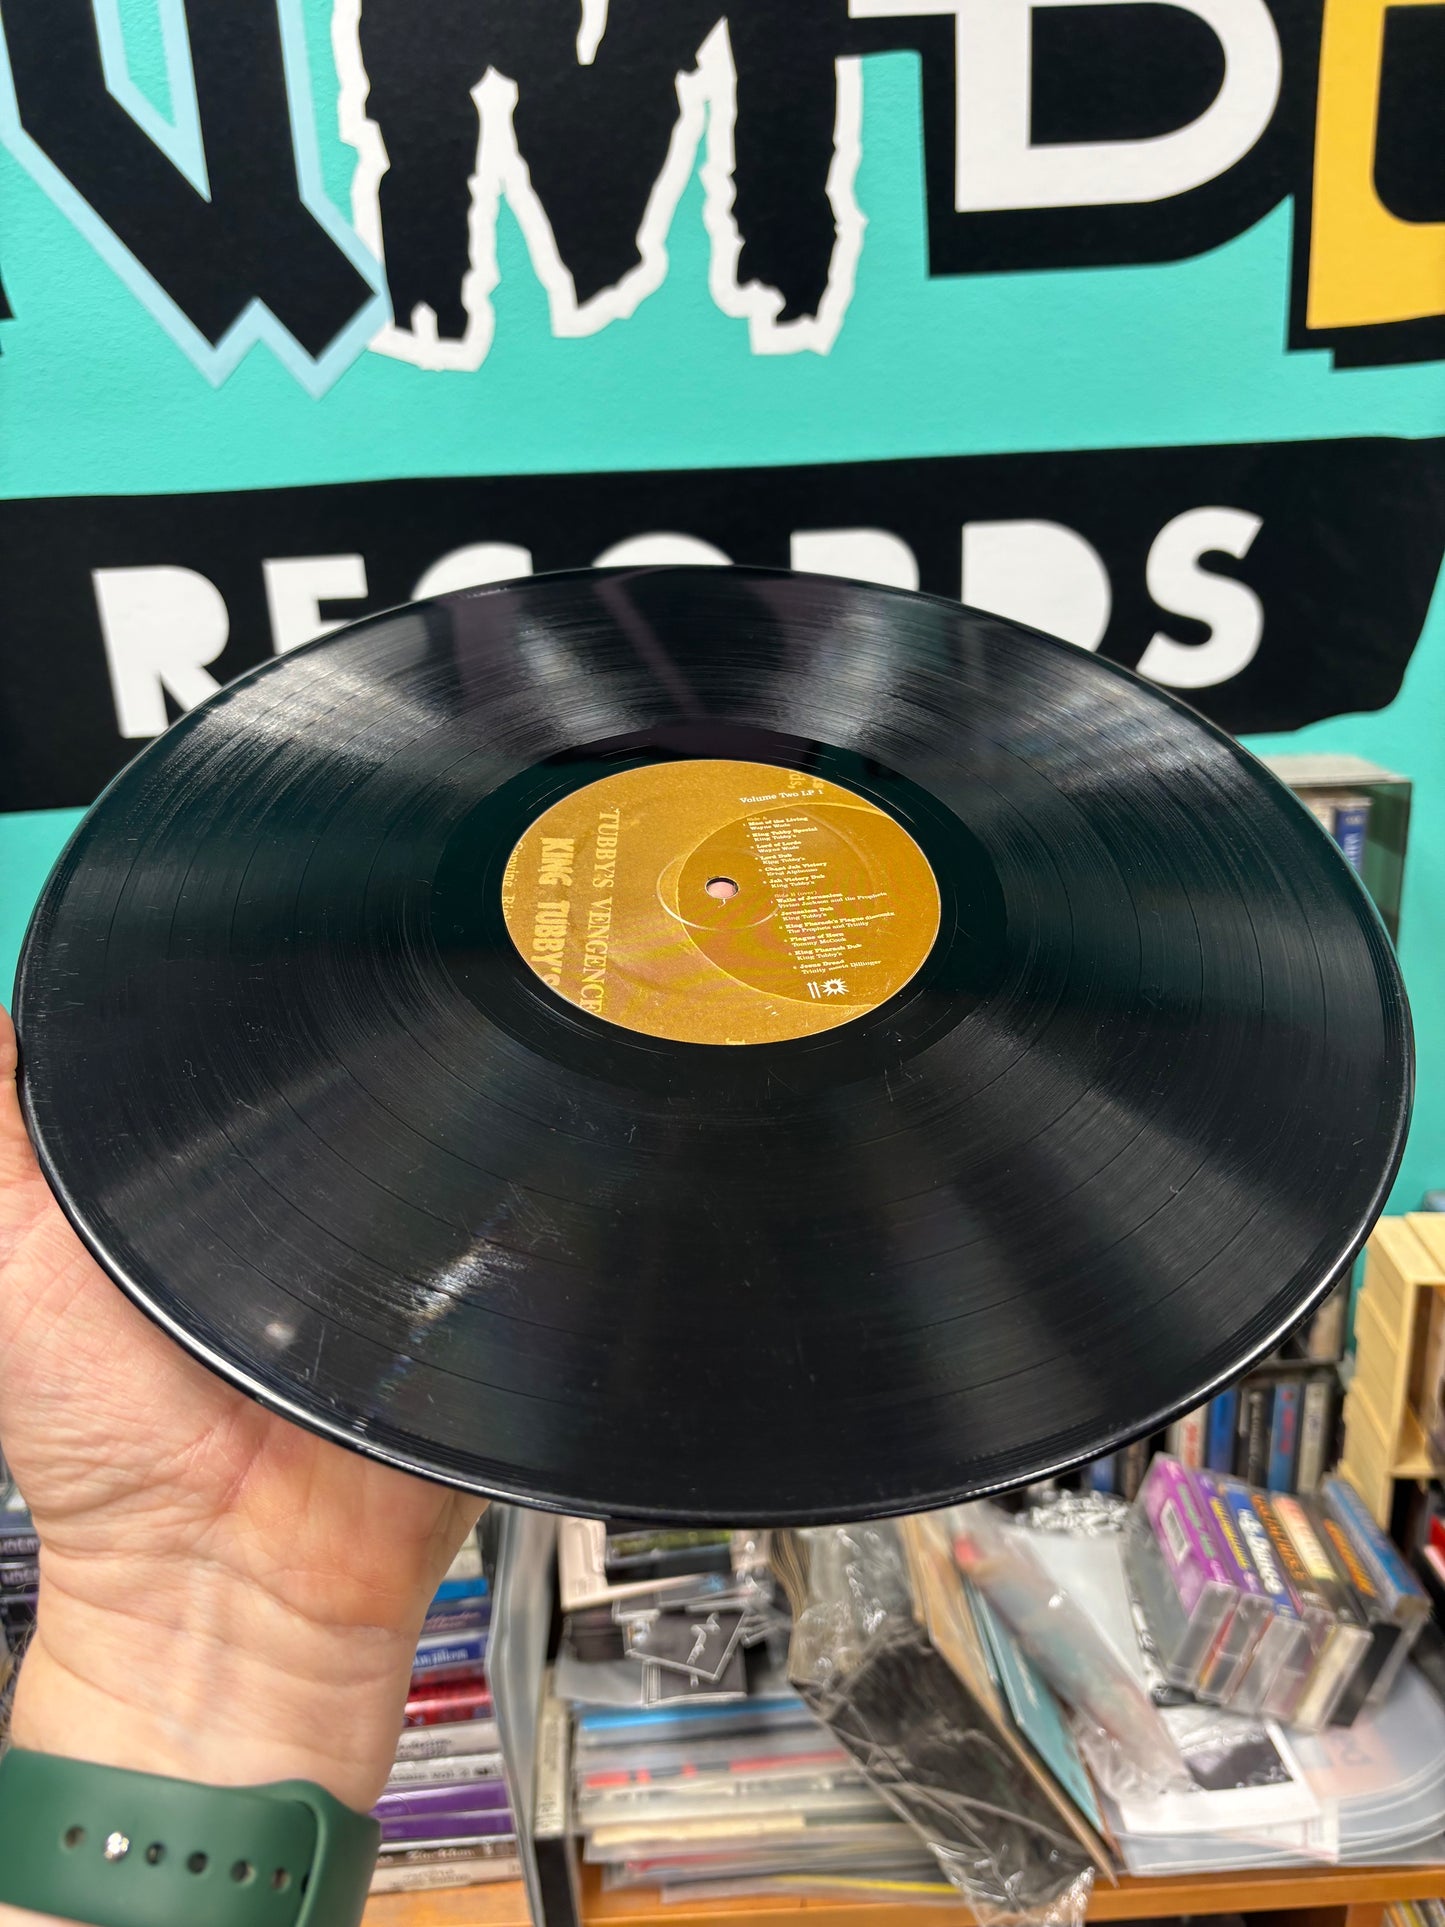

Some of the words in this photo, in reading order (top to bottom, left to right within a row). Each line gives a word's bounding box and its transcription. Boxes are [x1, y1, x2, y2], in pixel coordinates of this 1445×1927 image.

[92, 506, 1264, 739] REDS
[739, 794, 777, 803] Volume
[538, 837, 575, 887] KING
[592, 810, 620, 888] TUBBY'S
[580, 897, 613, 1013] VENGENCE
